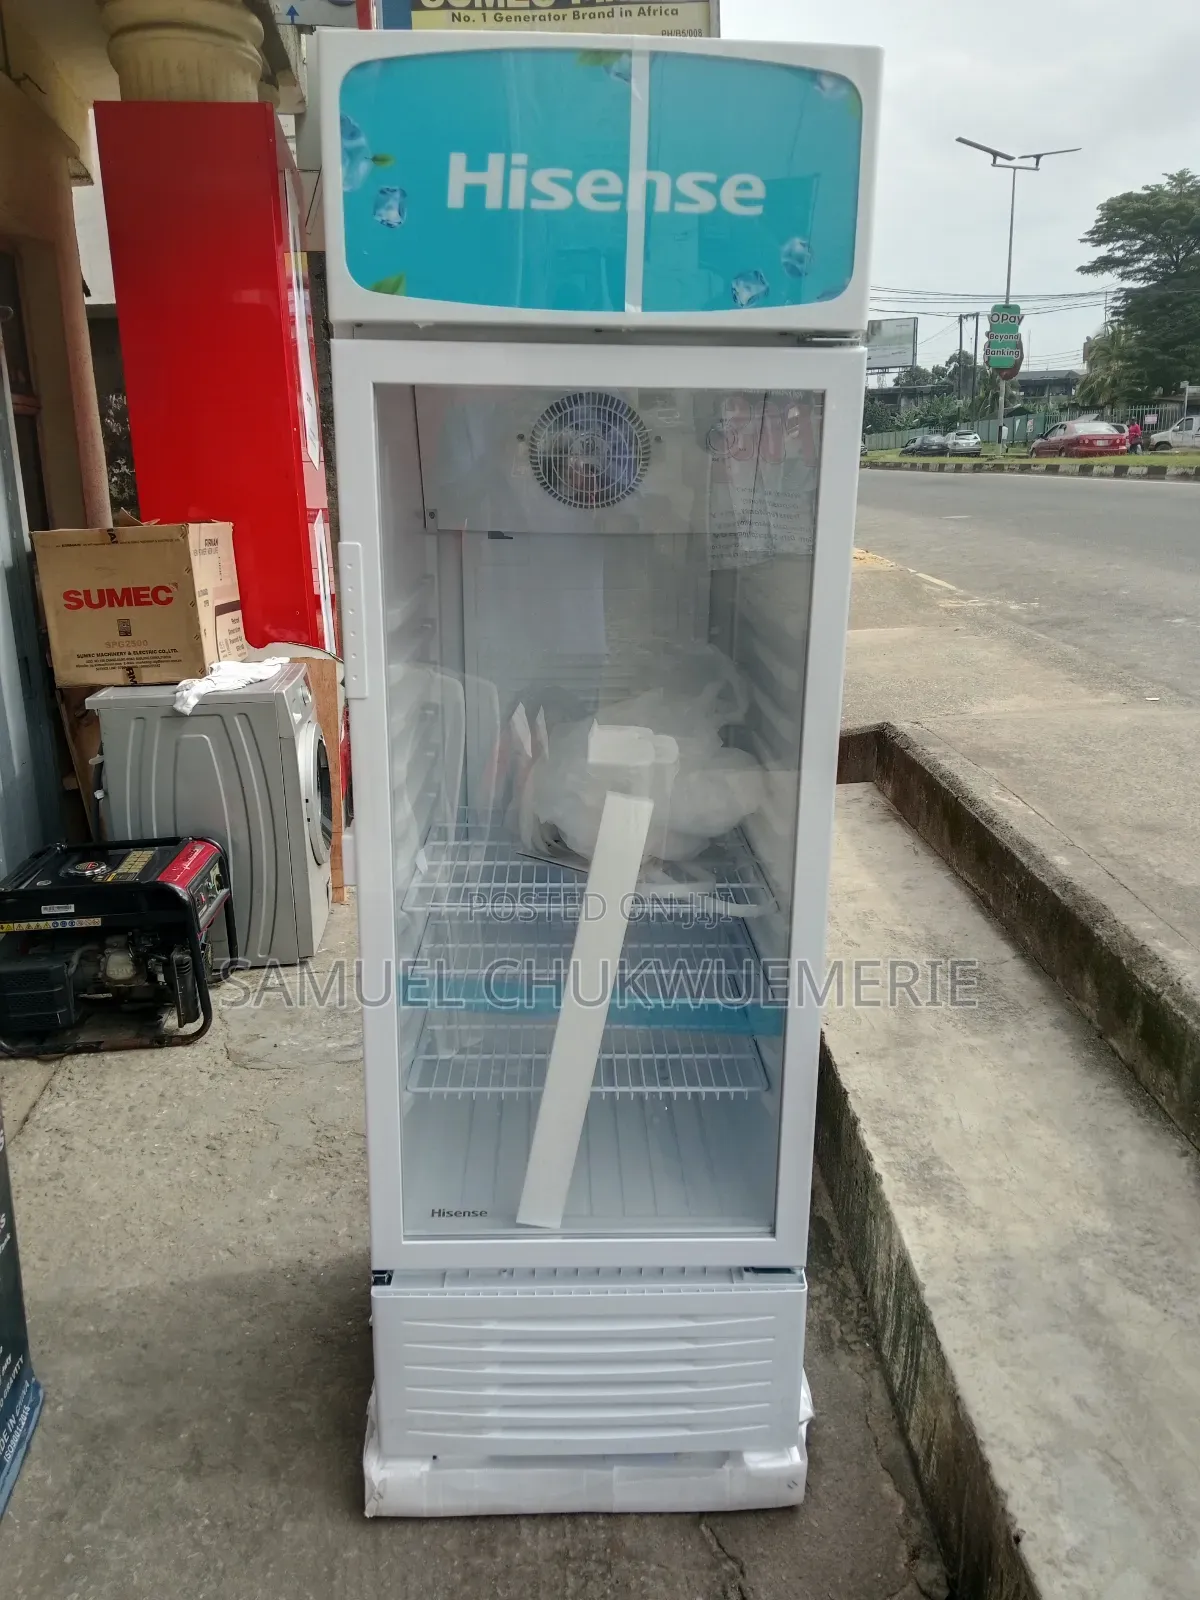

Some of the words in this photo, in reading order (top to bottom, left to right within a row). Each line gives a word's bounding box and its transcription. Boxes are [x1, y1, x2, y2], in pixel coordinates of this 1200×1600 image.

[451, 12, 476, 22] No.
[481, 12, 487, 22] 1
[493, 11, 568, 22] Generator
[572, 7, 615, 20] Brand
[619, 7, 633, 17] in
[637, 5, 679, 17] Africa
[447, 152, 767, 216] Hisense
[990, 312, 1025, 326] OPay
[989, 333, 1020, 342] Beyond
[985, 348, 1020, 359] Banking
[62, 585, 174, 611] SUMEC
[431, 1208, 488, 1218] Hisense
